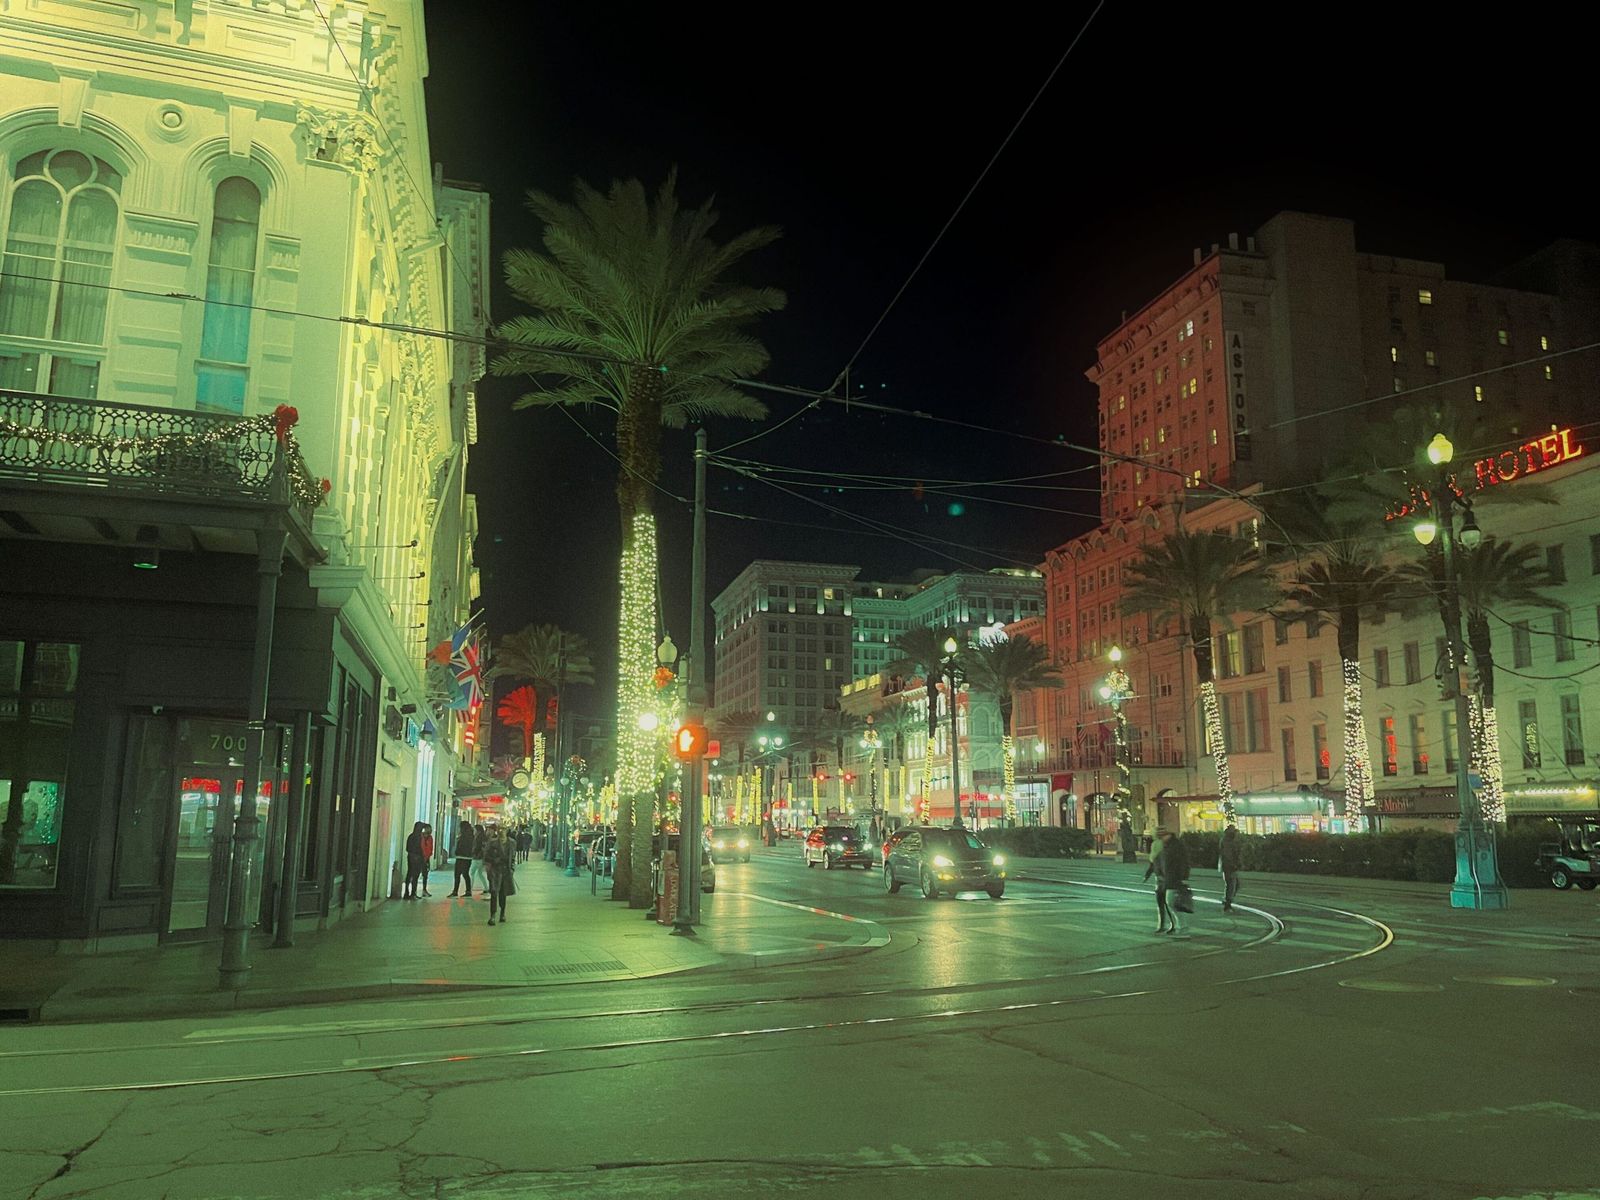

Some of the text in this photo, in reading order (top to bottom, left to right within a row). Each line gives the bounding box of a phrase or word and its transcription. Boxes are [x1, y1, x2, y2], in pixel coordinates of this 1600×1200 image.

[1232, 333, 1246, 429] ASTOR
[1474, 427, 1583, 491] HOTEL
[210, 734, 247, 752] 700
